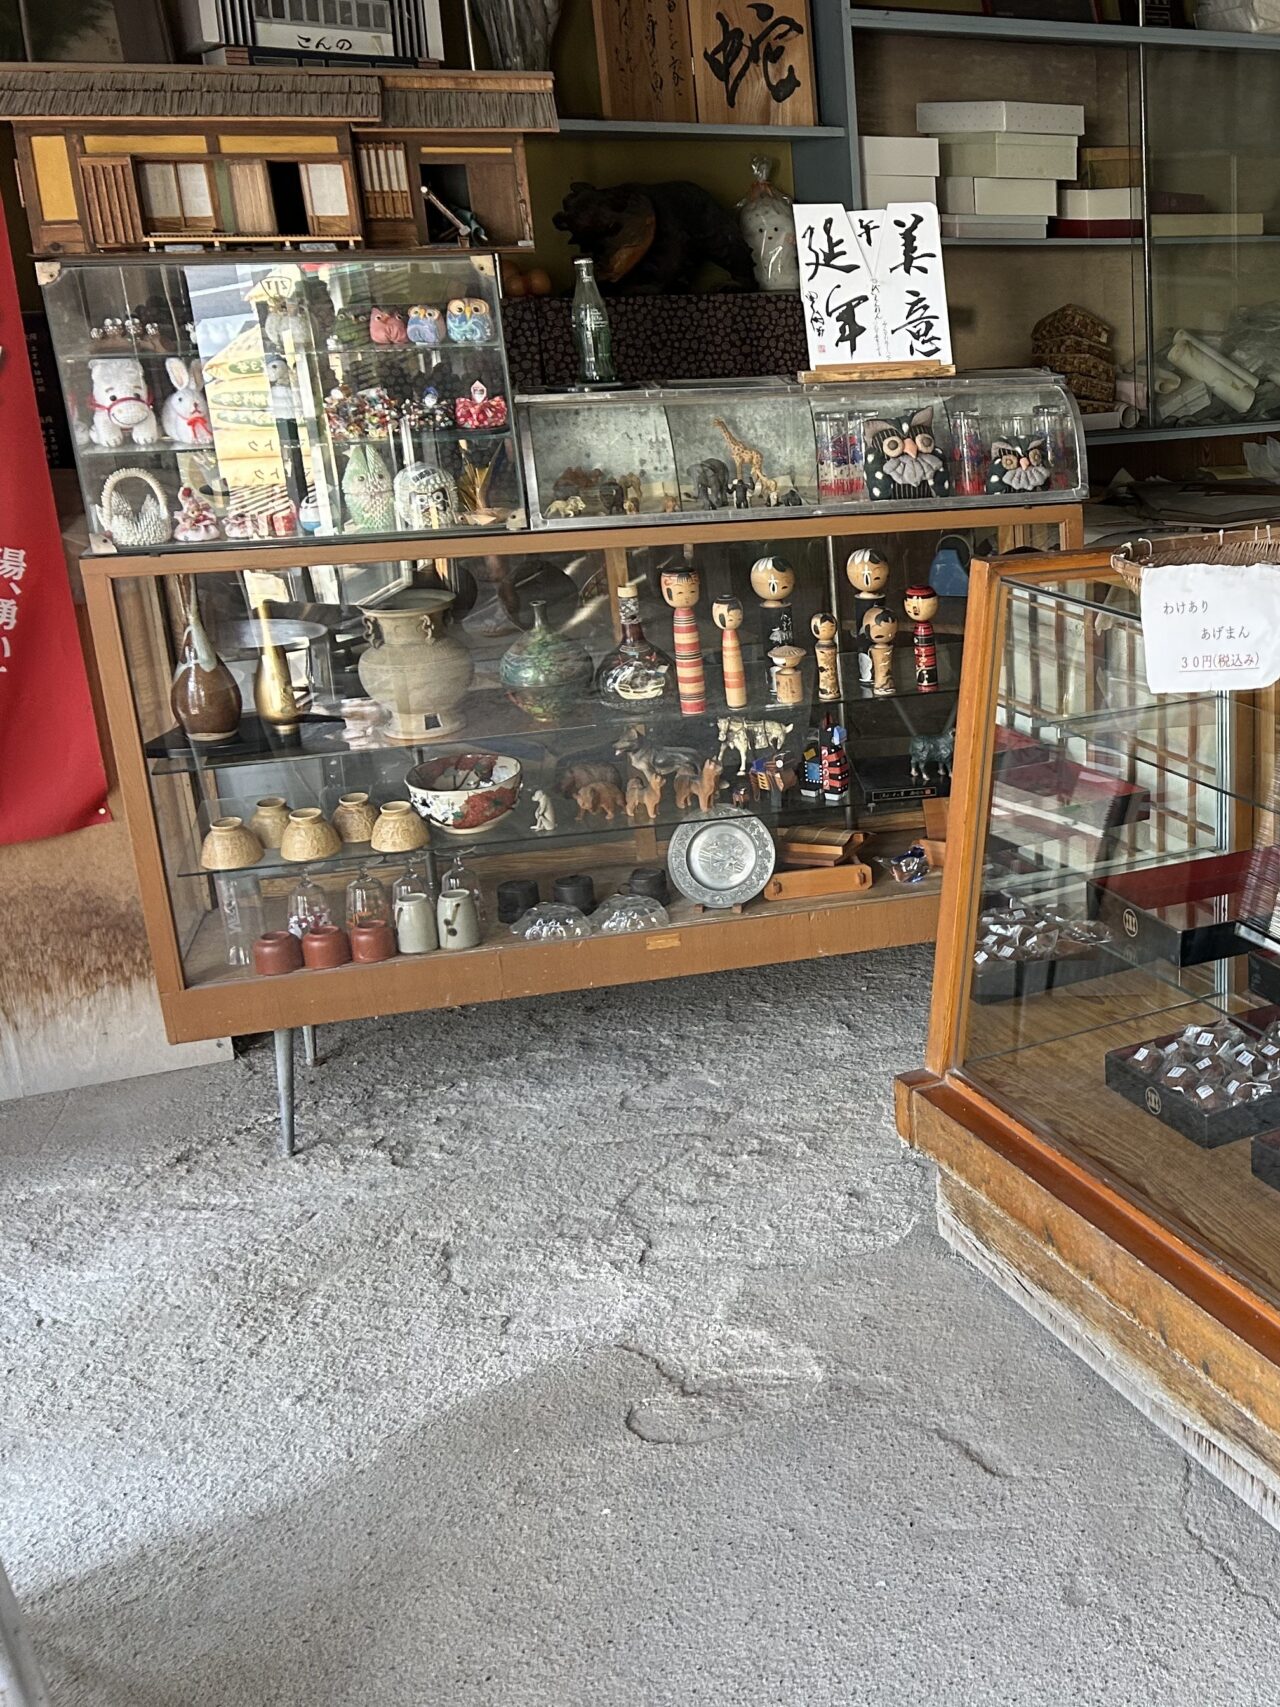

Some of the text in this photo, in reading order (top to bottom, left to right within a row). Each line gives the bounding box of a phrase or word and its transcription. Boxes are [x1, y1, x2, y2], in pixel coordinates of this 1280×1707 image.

[296, 34, 353, 51] こんの
[703, 3, 804, 108] 蛇
[857, 218, 880, 247] 午
[1162, 600, 1209, 615] わけあり
[1201, 625, 1250, 641] あげまん
